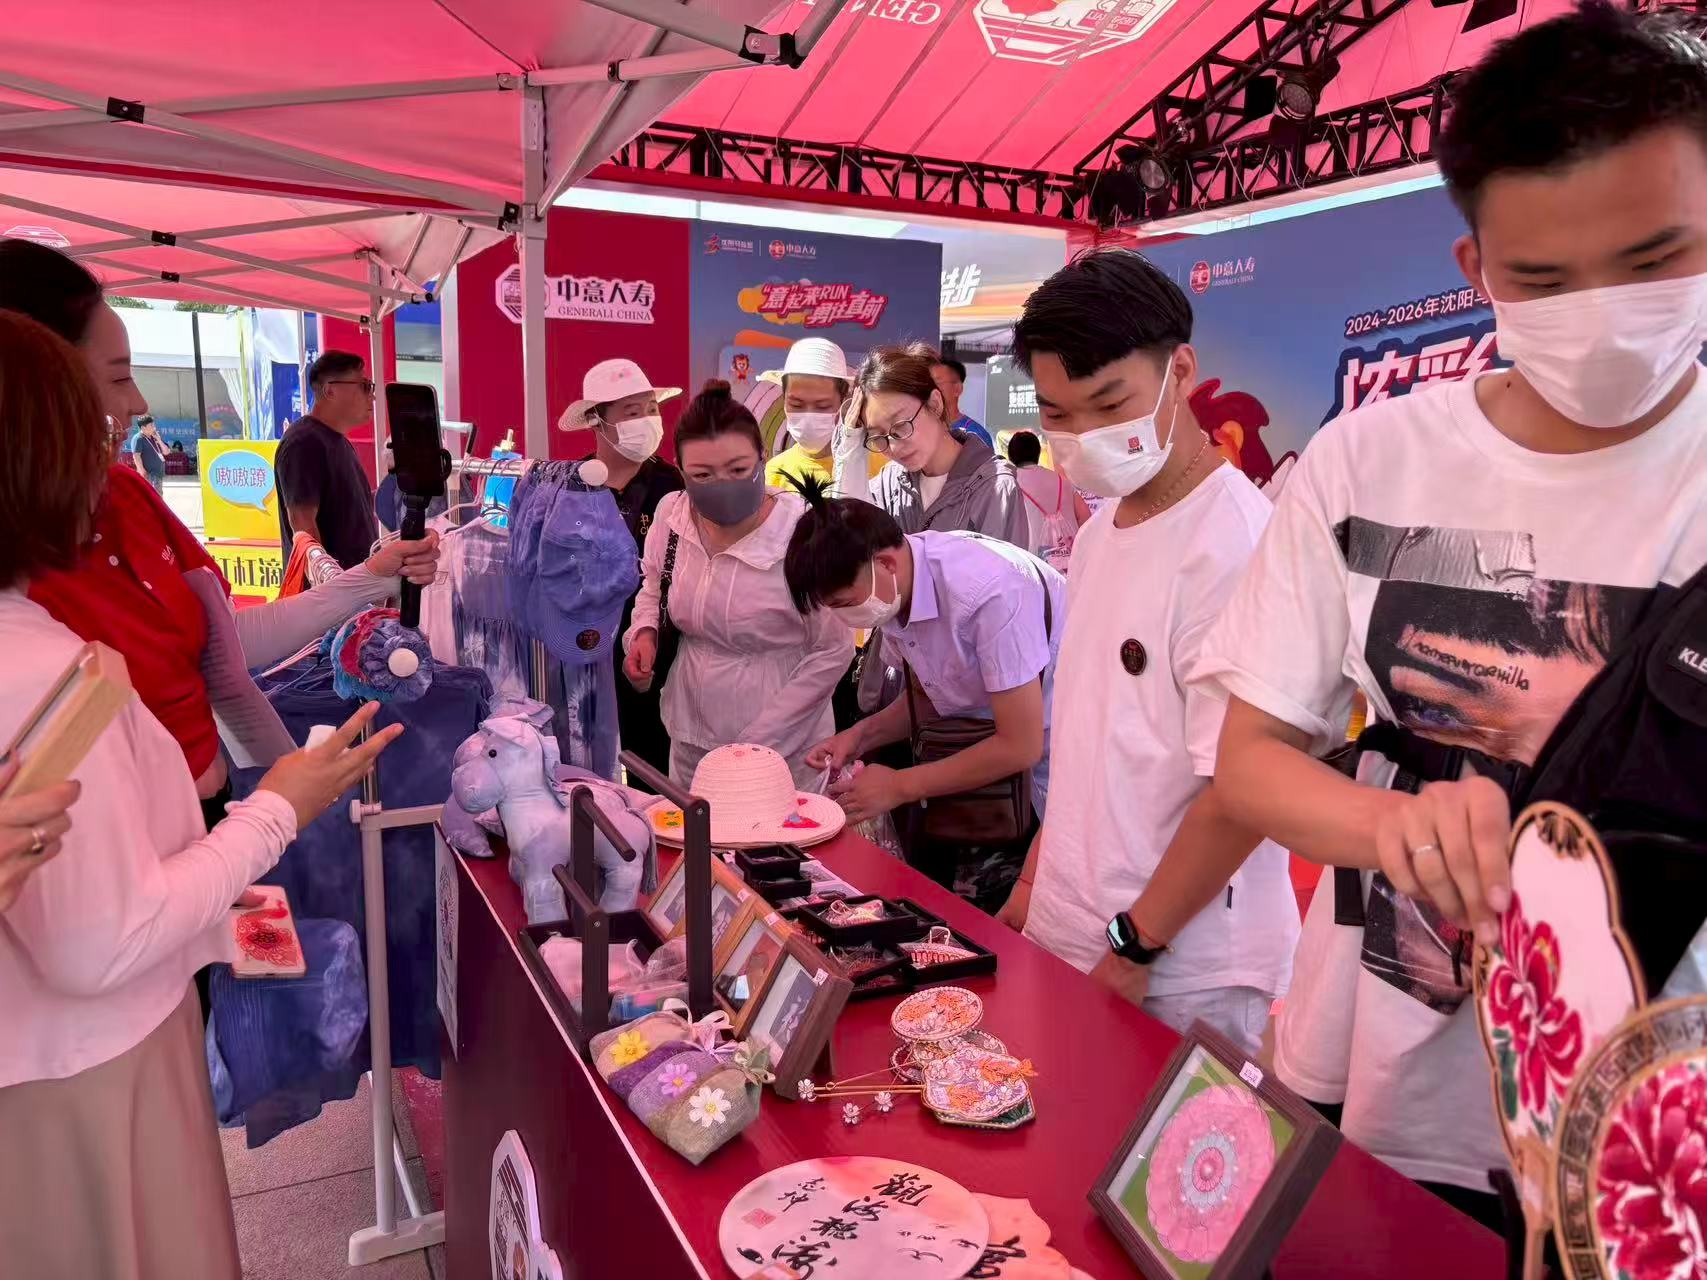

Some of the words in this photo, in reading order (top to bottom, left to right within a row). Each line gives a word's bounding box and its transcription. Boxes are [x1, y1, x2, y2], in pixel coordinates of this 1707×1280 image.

[1212, 256, 1255, 278] 中意人寿
[557, 279, 652, 306] 中意人寿
[558, 306, 614, 318] GENERALI
[616, 310, 651, 321] CHINA
[808, 290, 886, 326] 勇往直前
[215, 467, 267, 488] 嗷嗷蹽
